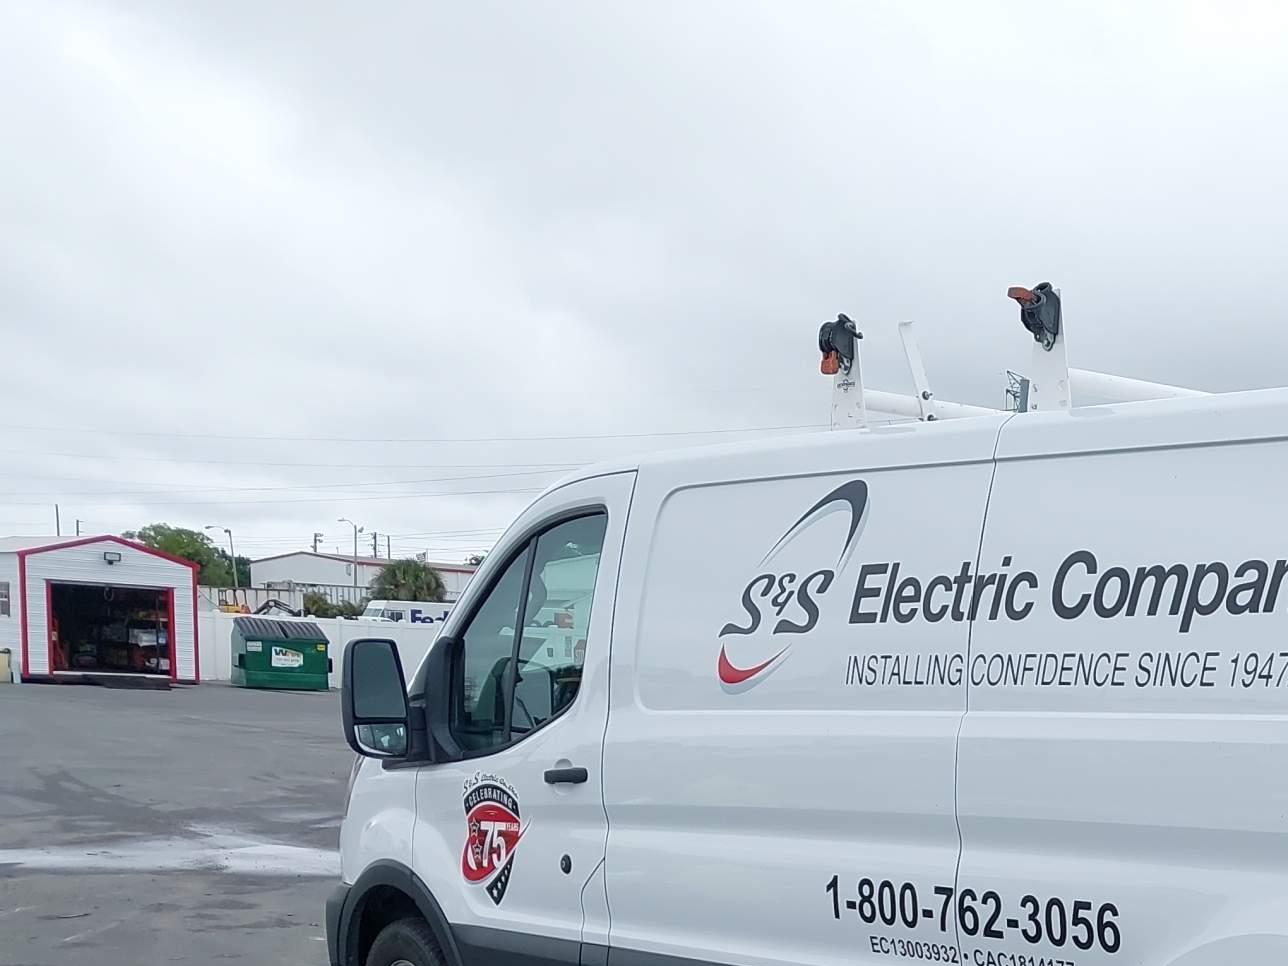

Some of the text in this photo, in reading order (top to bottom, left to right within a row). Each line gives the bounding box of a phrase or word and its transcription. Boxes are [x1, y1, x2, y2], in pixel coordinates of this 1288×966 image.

[718, 569, 835, 638] S&S
[849, 556, 1039, 625] Electric
[845, 654, 964, 687] INSTALLING
[970, 653, 1130, 687] CONFIDENCE
[1134, 652, 1220, 688] SINCE
[468, 787, 513, 810] CELEBRATING
[480, 821, 506, 869] 75
[826, 875, 1121, 954] 1-800-762-3056
[869, 935, 960, 964] EC13003932
